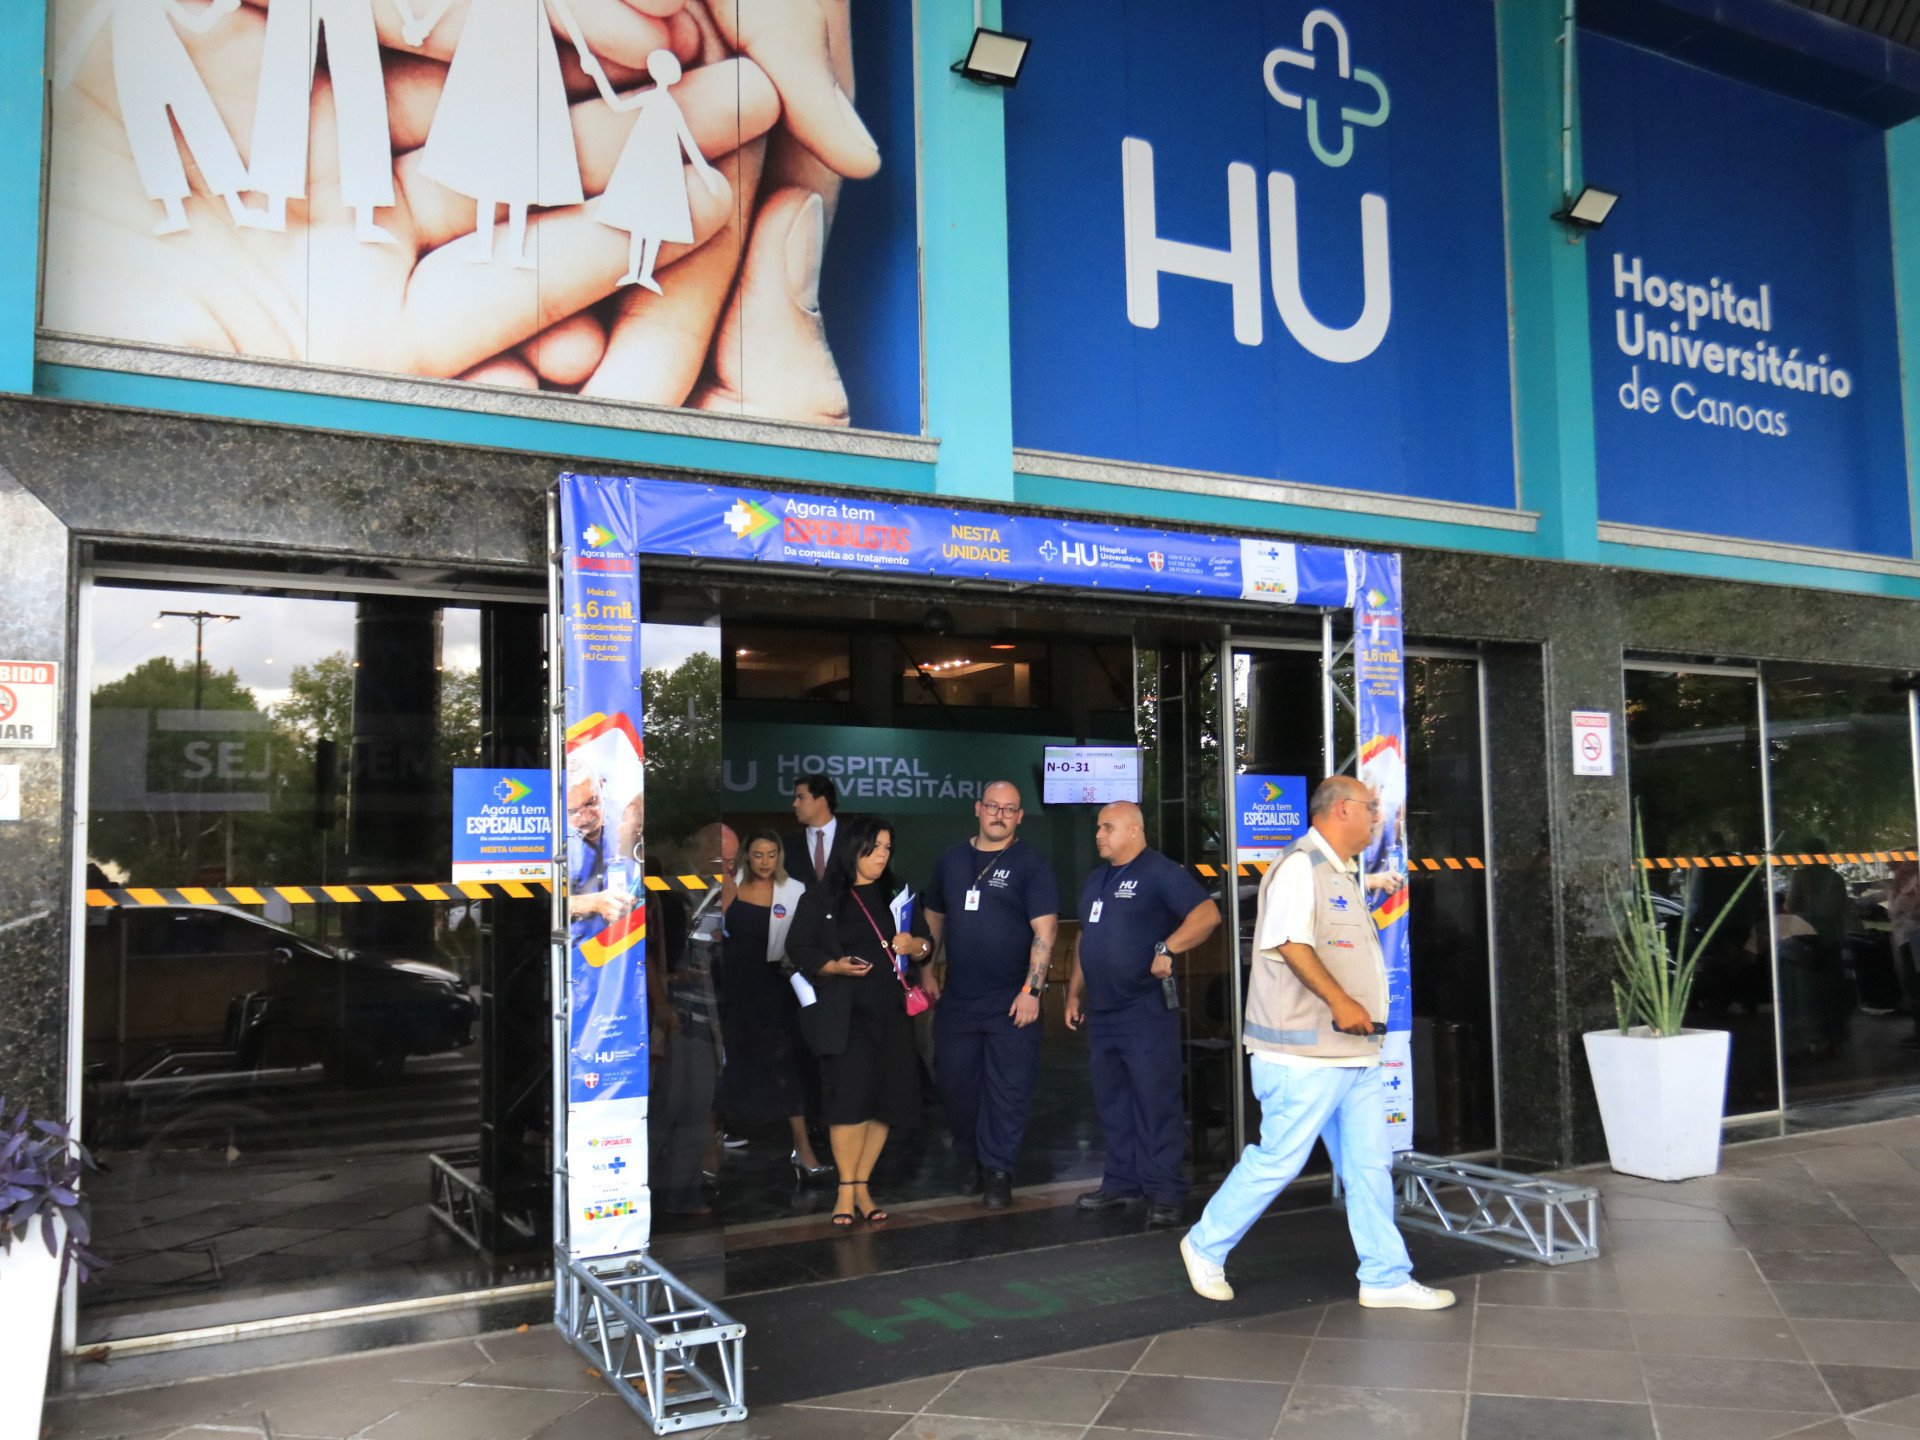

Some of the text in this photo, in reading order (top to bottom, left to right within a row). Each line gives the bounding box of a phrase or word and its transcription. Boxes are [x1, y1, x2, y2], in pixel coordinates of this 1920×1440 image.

[1122, 136, 1393, 364] HU
[1613, 253, 1770, 331] Hospital
[1616, 309, 1850, 398] Universitário
[1618, 365, 1787, 437] de Canoas
[784, 499, 875, 521] Agora tem
[784, 517, 910, 553] ESPECIALISTAS
[951, 524, 1001, 543] NESTA
[581, 549, 605, 559] Agora
[784, 546, 909, 565] Da consulta ao tratamento
[942, 543, 1011, 563] UNIDADE
[1062, 541, 1098, 567] HU
[1099, 545, 1127, 555] Hospital
[1100, 552, 1143, 564] Universitário
[1109, 562, 1131, 570] Canoas
[587, 588, 617, 597] Mais de
[572, 600, 634, 619] 1,6 mil
[572, 623, 634, 633] procedimentos
[582, 653, 626, 662] HU Canoas
[777, 754, 930, 777] HOSPITAL
[1047, 762, 1090, 772] N-O-31
[777, 773, 994, 799] UVERSITÁRI
[480, 804, 546, 817] Agora tem
[1252, 802, 1292, 812] Agora tem
[466, 816, 552, 834] ESPECIALISTA
[1243, 812, 1300, 826] ESPECIALISTAS
[480, 845, 545, 854] NESTA UNIDADE
[993, 869, 1010, 879] HU
[1119, 880, 1138, 889] HU
[595, 1050, 615, 1063] HU
[829, 1281, 1069, 1344] HU
